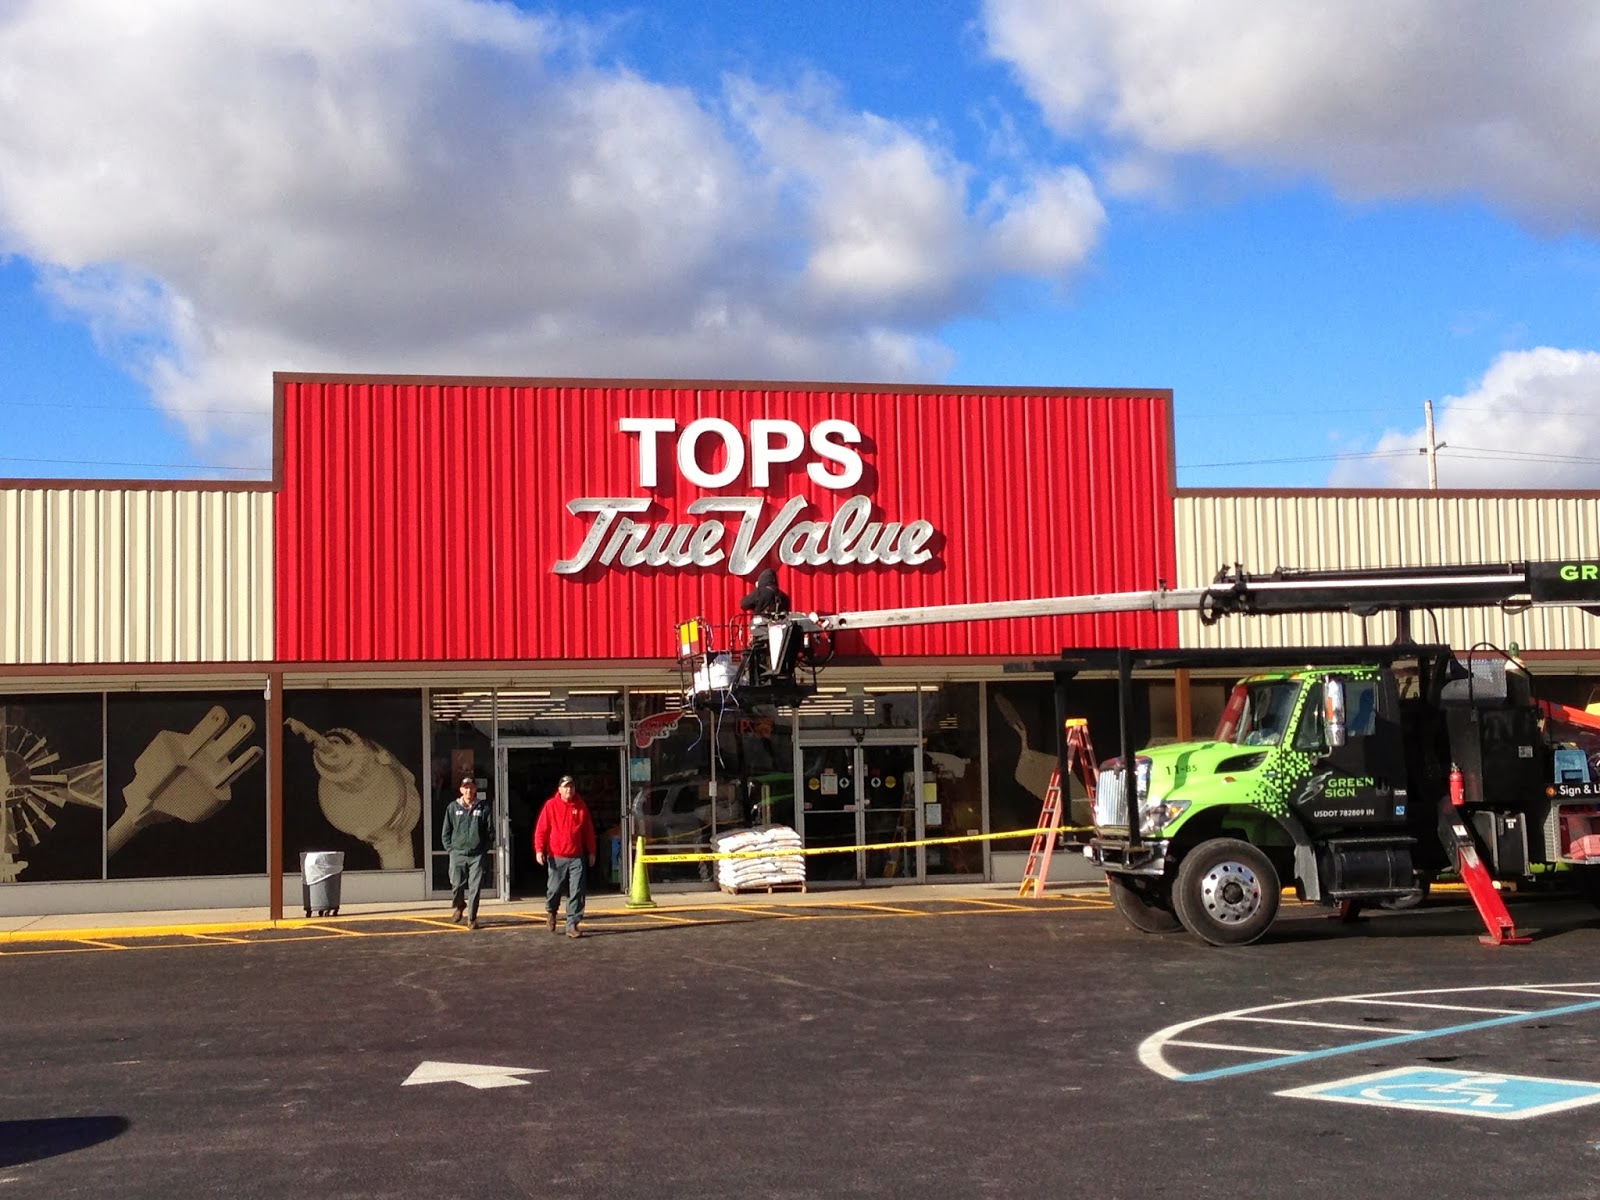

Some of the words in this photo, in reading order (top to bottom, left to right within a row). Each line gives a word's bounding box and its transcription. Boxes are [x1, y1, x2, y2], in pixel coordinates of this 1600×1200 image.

[619, 417, 863, 489] TOPS
[552, 496, 726, 575] True
[686, 494, 933, 576] Value
[1560, 565, 1598, 580] GR
[1328, 777, 1374, 788] GREEN
[1324, 788, 1356, 798] SIGN
[1559, 785, 1581, 797] Sign
[1583, 784, 1592, 794] &
[1366, 808, 1375, 816] IN
